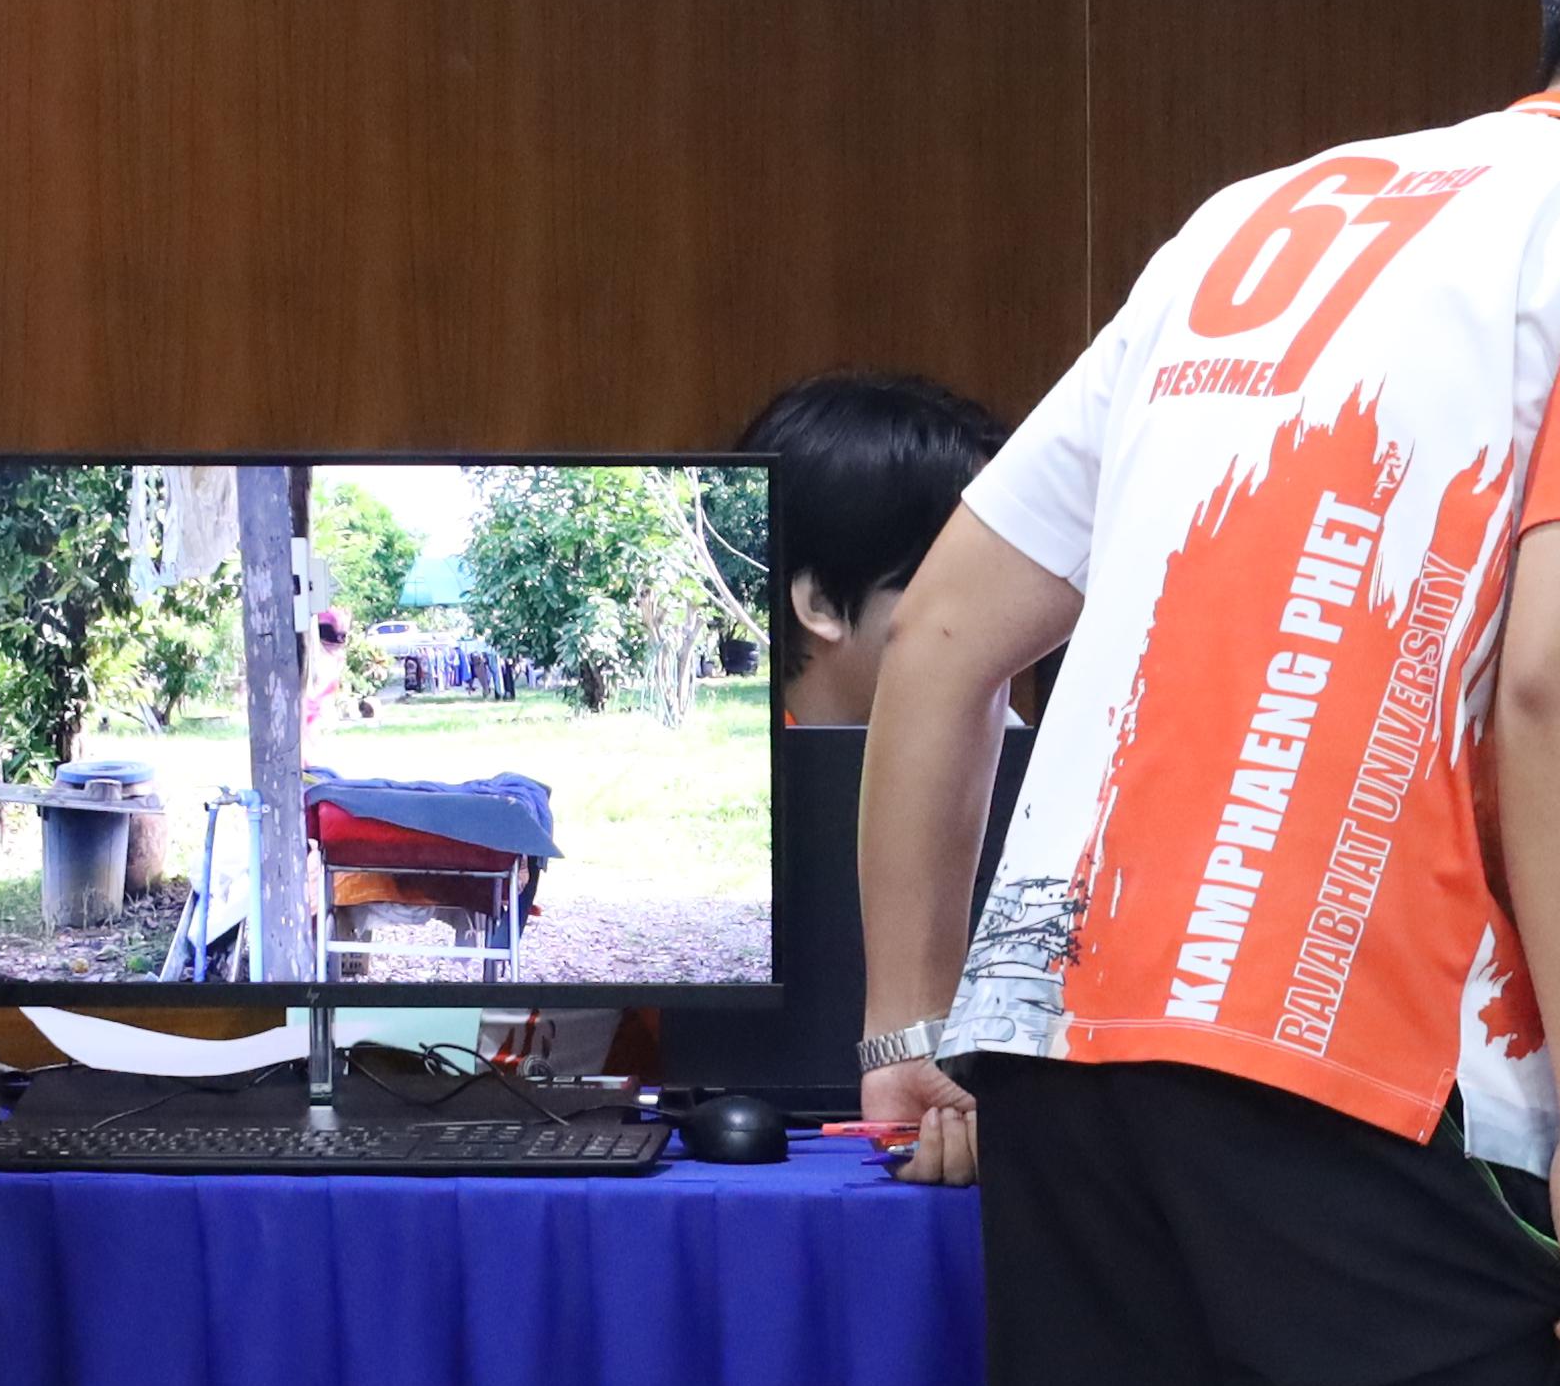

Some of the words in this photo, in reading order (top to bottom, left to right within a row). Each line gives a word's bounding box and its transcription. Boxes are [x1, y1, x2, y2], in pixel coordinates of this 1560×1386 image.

[1187, 156, 1461, 397] 67
[1383, 165, 1493, 194] KPRU
[1164, 650, 1333, 1024] KAMPHAENG
[1279, 489, 1383, 645] PHET
[1272, 817, 1392, 1058] RAJABHAT
[1347, 549, 1470, 824] UNIVERSITY
